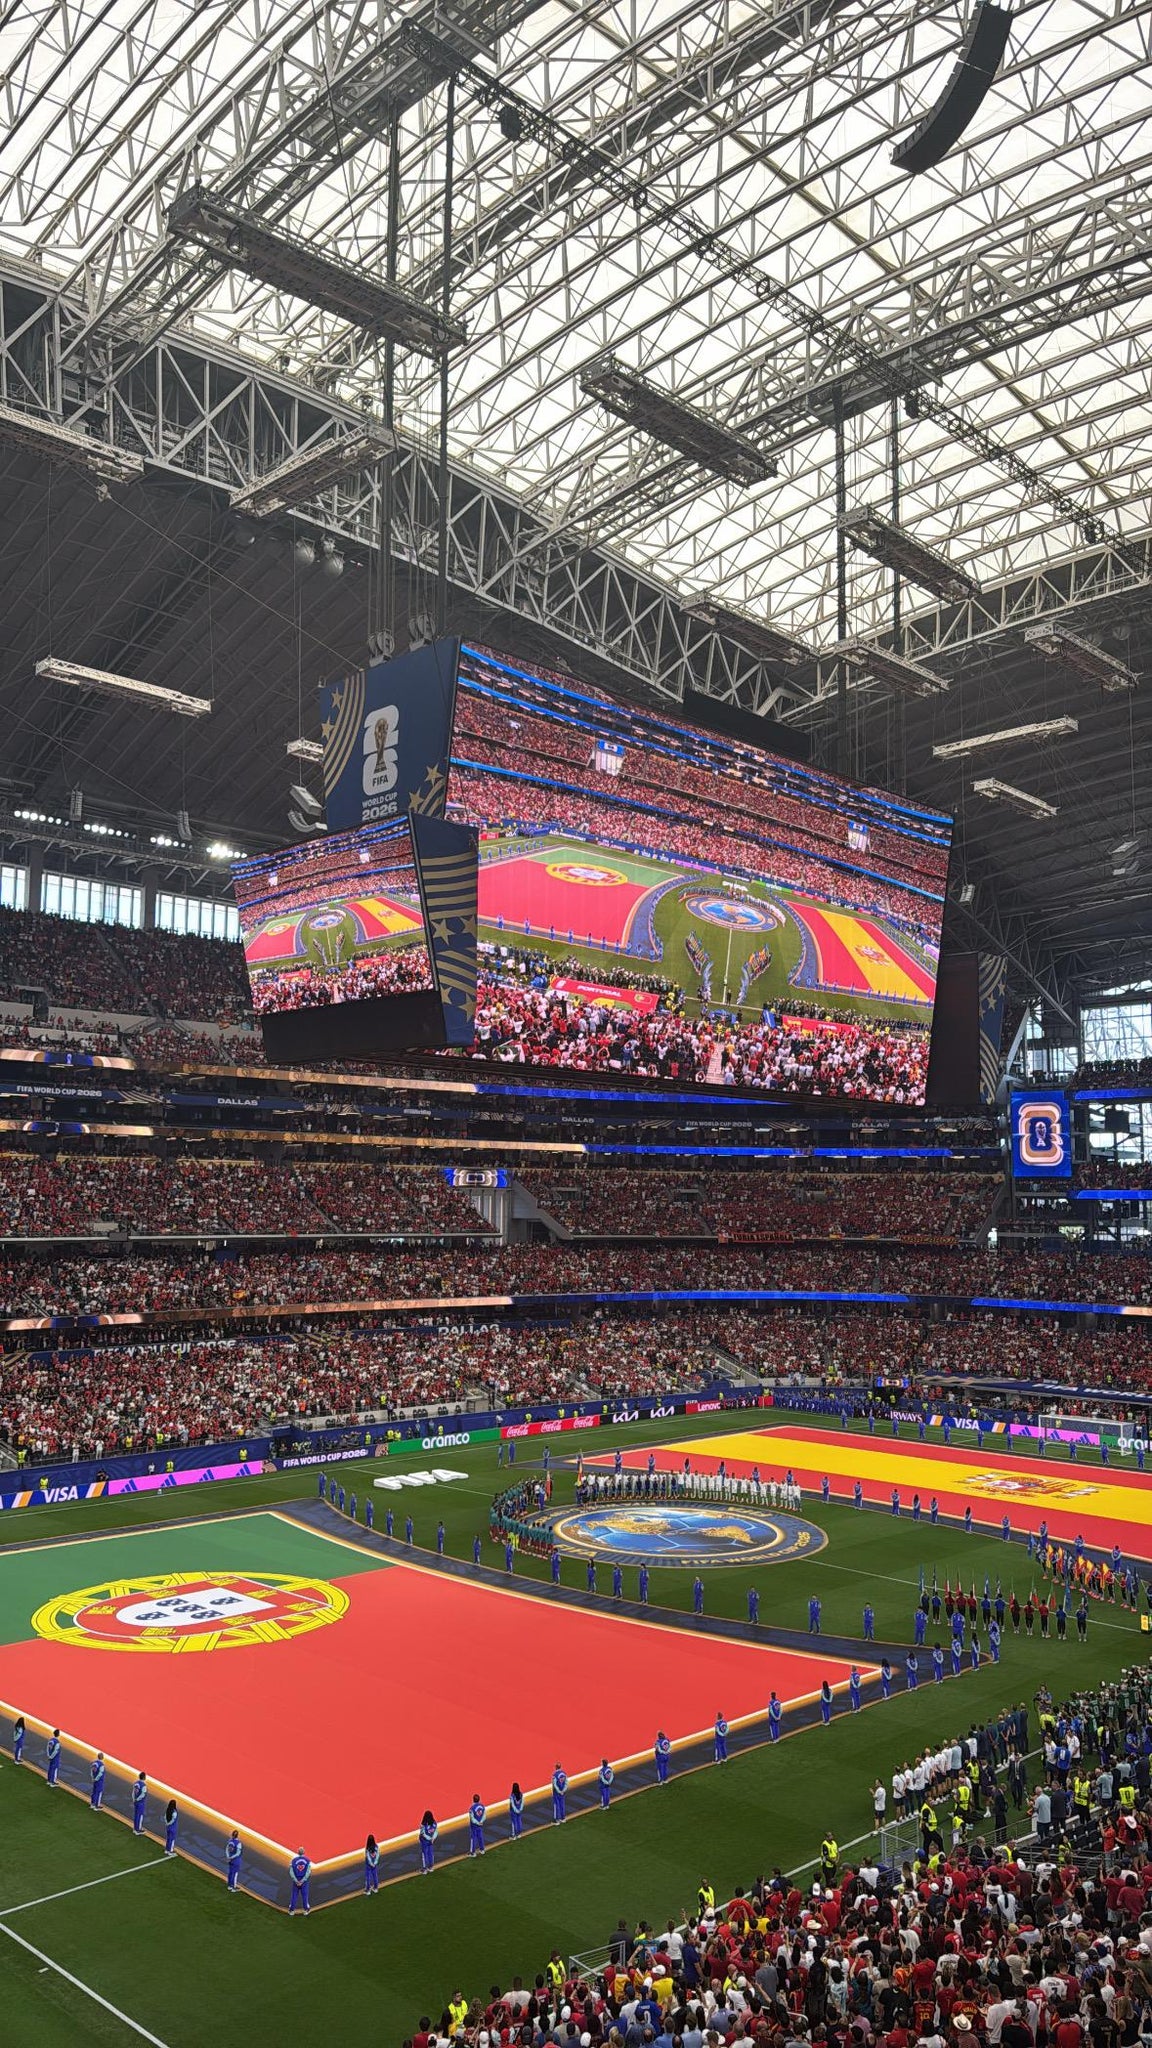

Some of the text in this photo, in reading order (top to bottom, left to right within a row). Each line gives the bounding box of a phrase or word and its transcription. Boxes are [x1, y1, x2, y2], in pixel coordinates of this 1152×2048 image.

[372, 774, 389, 787] FIFA
[362, 791, 398, 808] WORLD CUP
[362, 801, 398, 821] 2026
[577, 985, 622, 997] PORTUGAL
[16, 1085, 102, 1097] FIFA WORLD CUP 2026
[217, 1097, 258, 1106] DALLAS
[561, 1116, 595, 1124] DALLAS
[952, 1417, 980, 1430] VISA
[422, 1432, 470, 1450] aramco
[283, 1448, 366, 1468] FIFA WORLD CUP 2026
[374, 1469, 469, 1490] FIFA
[41, 1485, 78, 1504] VISA
